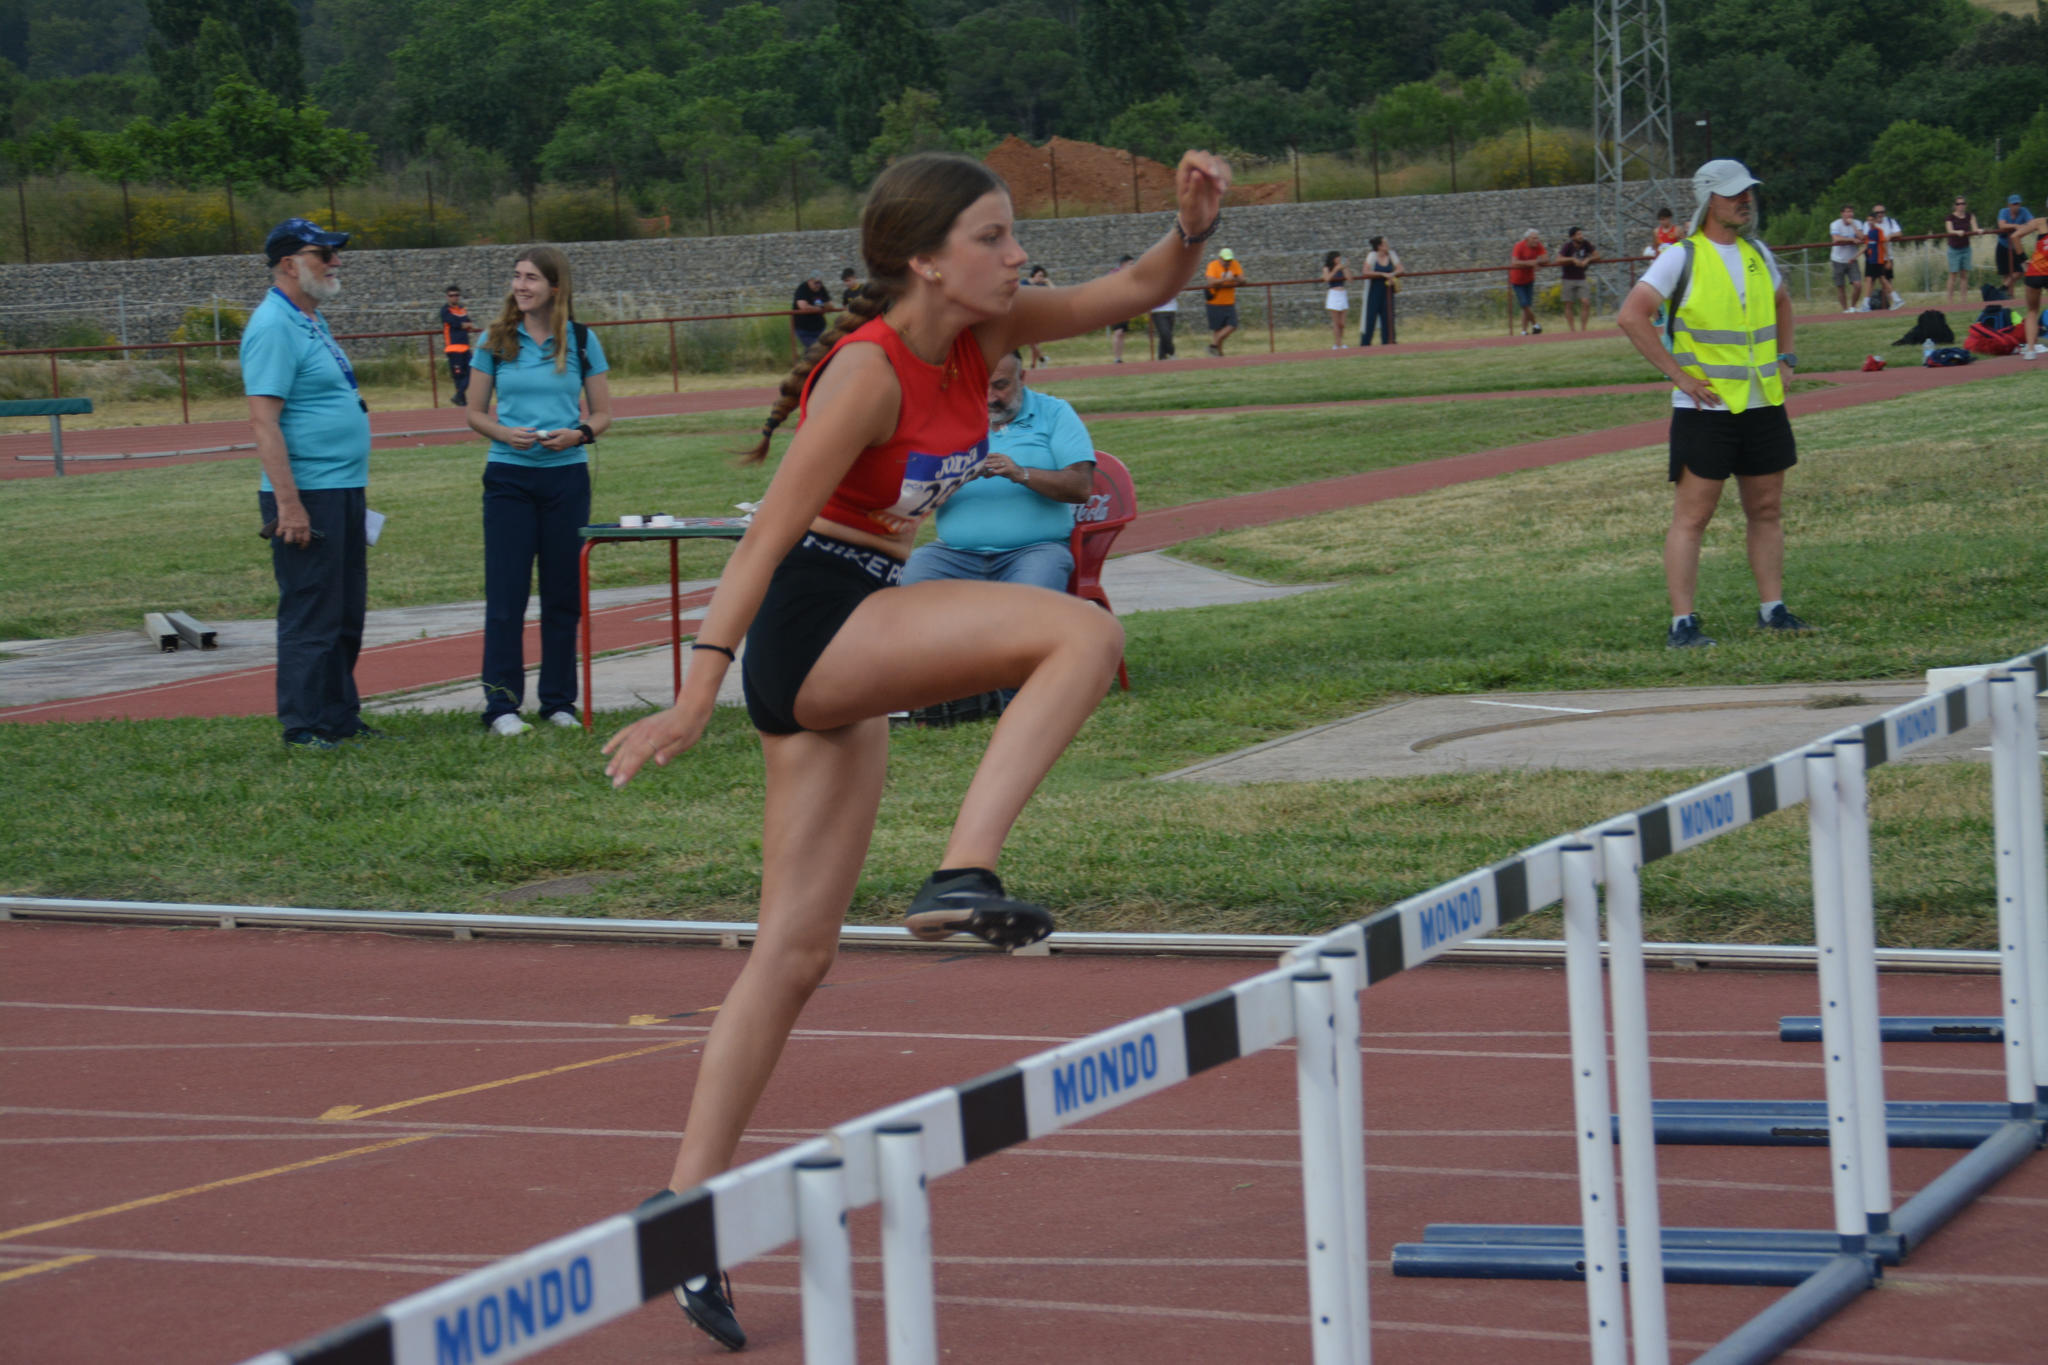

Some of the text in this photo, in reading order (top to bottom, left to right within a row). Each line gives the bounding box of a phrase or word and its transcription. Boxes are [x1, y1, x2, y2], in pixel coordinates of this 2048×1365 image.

[802, 535, 889, 578] NIKE
[1895, 705, 1938, 748] MONDO
[1679, 791, 1735, 841] MONDO
[1418, 886, 1482, 951] MONDO
[1052, 1032, 1157, 1116] MONDO
[434, 1254, 593, 1365] MONDO
